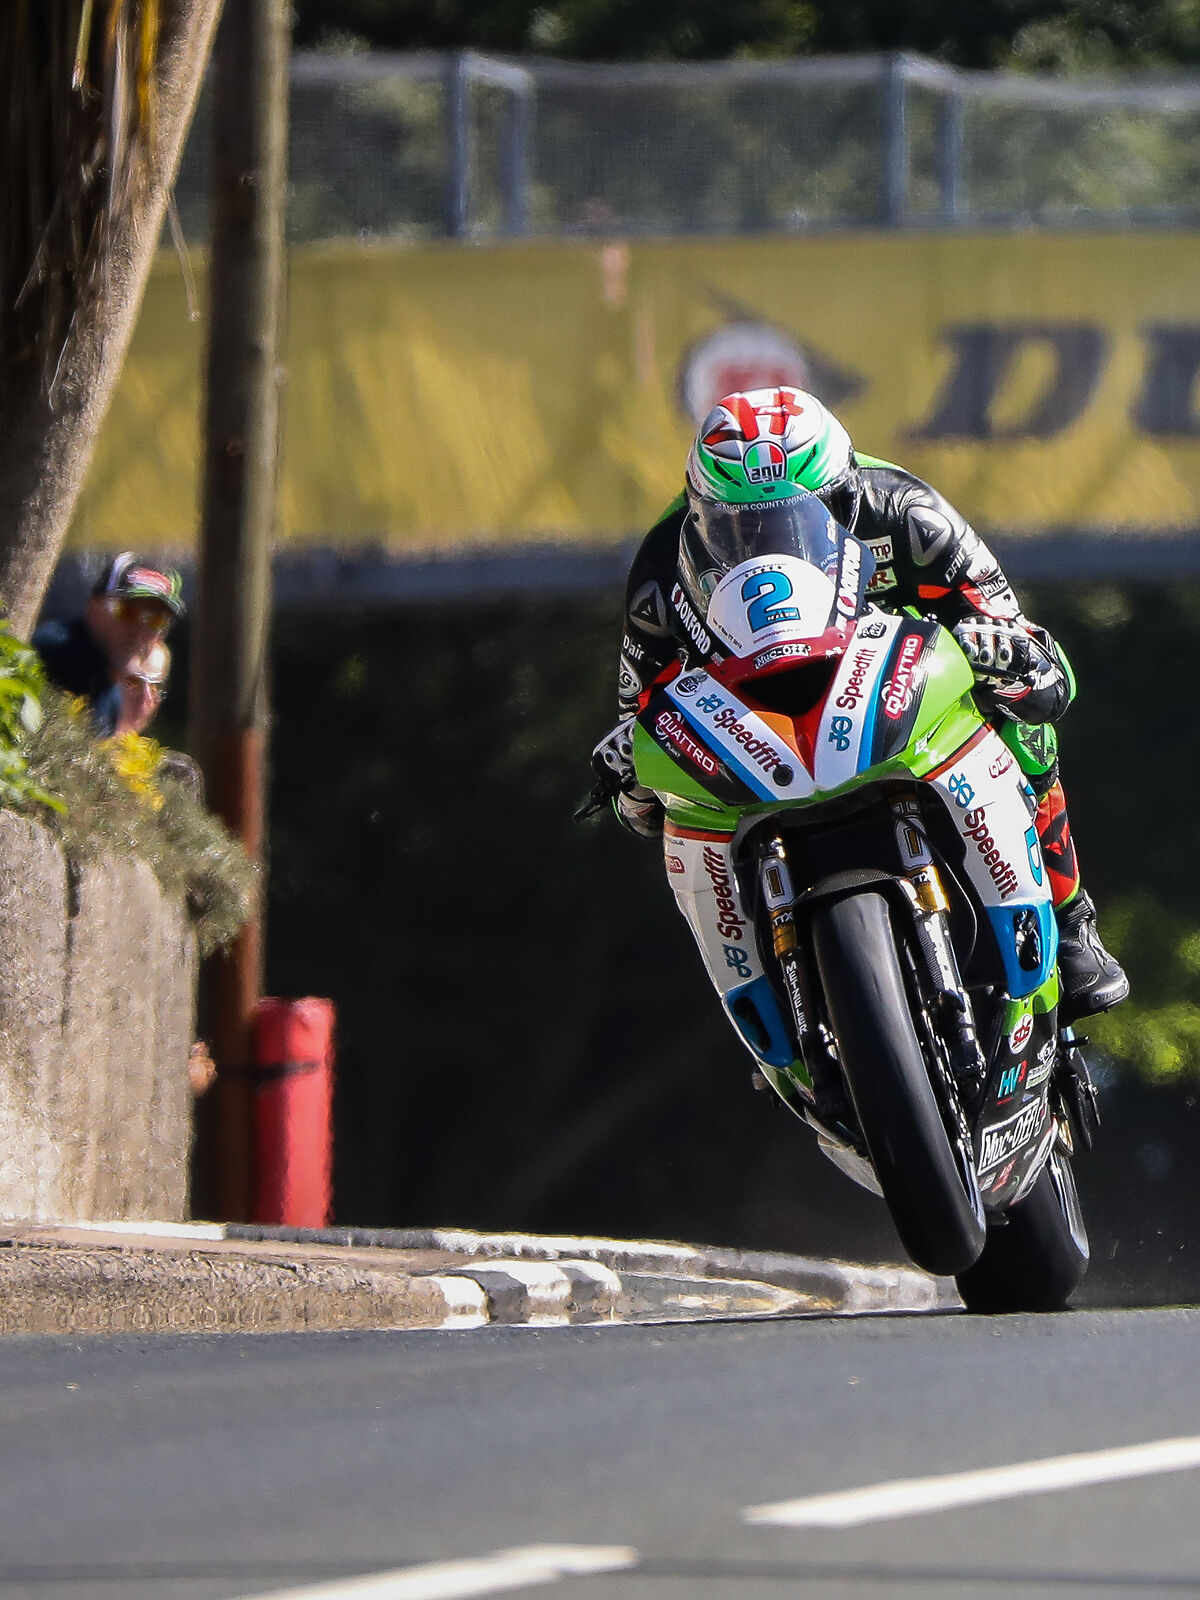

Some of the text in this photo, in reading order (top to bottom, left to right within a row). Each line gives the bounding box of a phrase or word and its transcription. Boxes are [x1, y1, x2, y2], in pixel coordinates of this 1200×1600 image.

[749, 464, 783, 482] agv
[750, 500, 785, 511] COUNTY
[785, 487, 825, 506] WINDOWS
[679, 604, 712, 655] OXFORD
[741, 570, 801, 633] 2
[836, 648, 877, 710] Speedfit
[887, 638, 918, 715] QUATTRO
[657, 711, 715, 773] QUATTRO
[713, 708, 783, 773] Speedfit
[962, 806, 1020, 900] Speedfit
[702, 846, 746, 940] Speedfit
[773, 911, 793, 926] TTX
[786, 960, 809, 1035] METZELER
